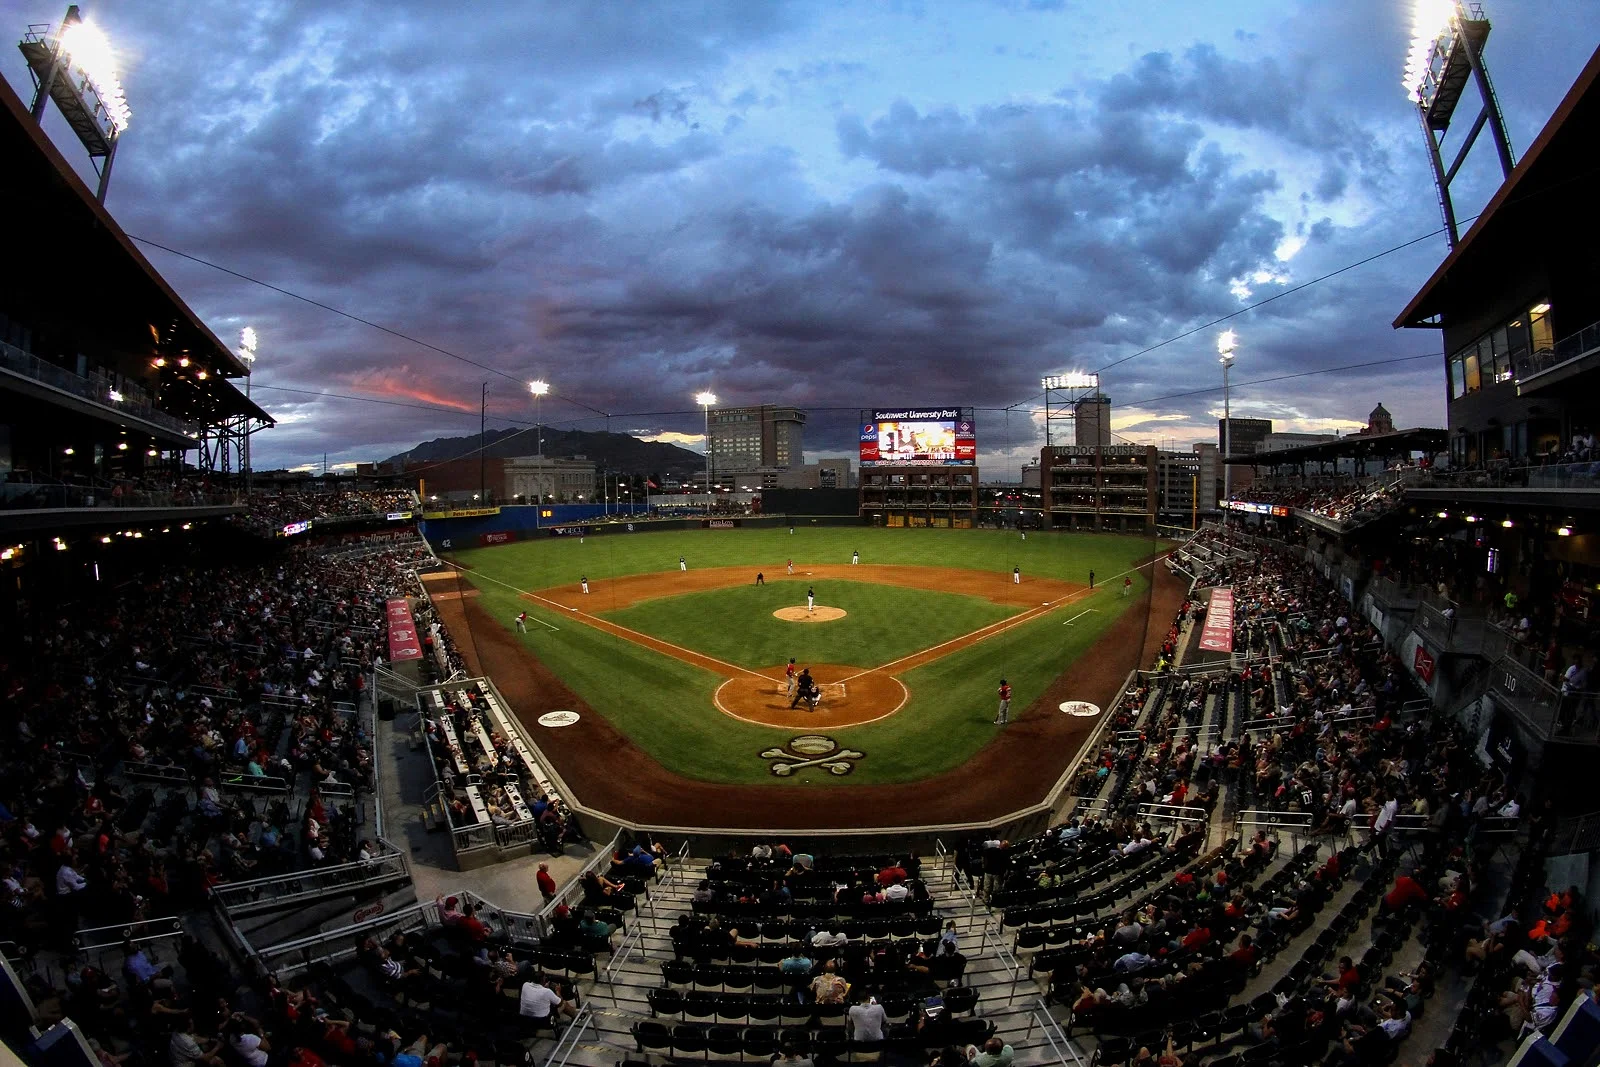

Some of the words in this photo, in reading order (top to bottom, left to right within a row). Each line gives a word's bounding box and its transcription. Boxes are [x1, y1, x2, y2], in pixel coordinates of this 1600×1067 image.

[875, 411, 908, 420] Southwest
[909, 411, 942, 419] University
[942, 410, 958, 418] Park
[1053, 445, 1071, 455] BIG
[1073, 445, 1096, 455] DOG
[1102, 445, 1134, 455] HOUSE
[393, 530, 414, 540] Patio
[442, 539, 451, 548] 42
[1504, 672, 1516, 692] 110
